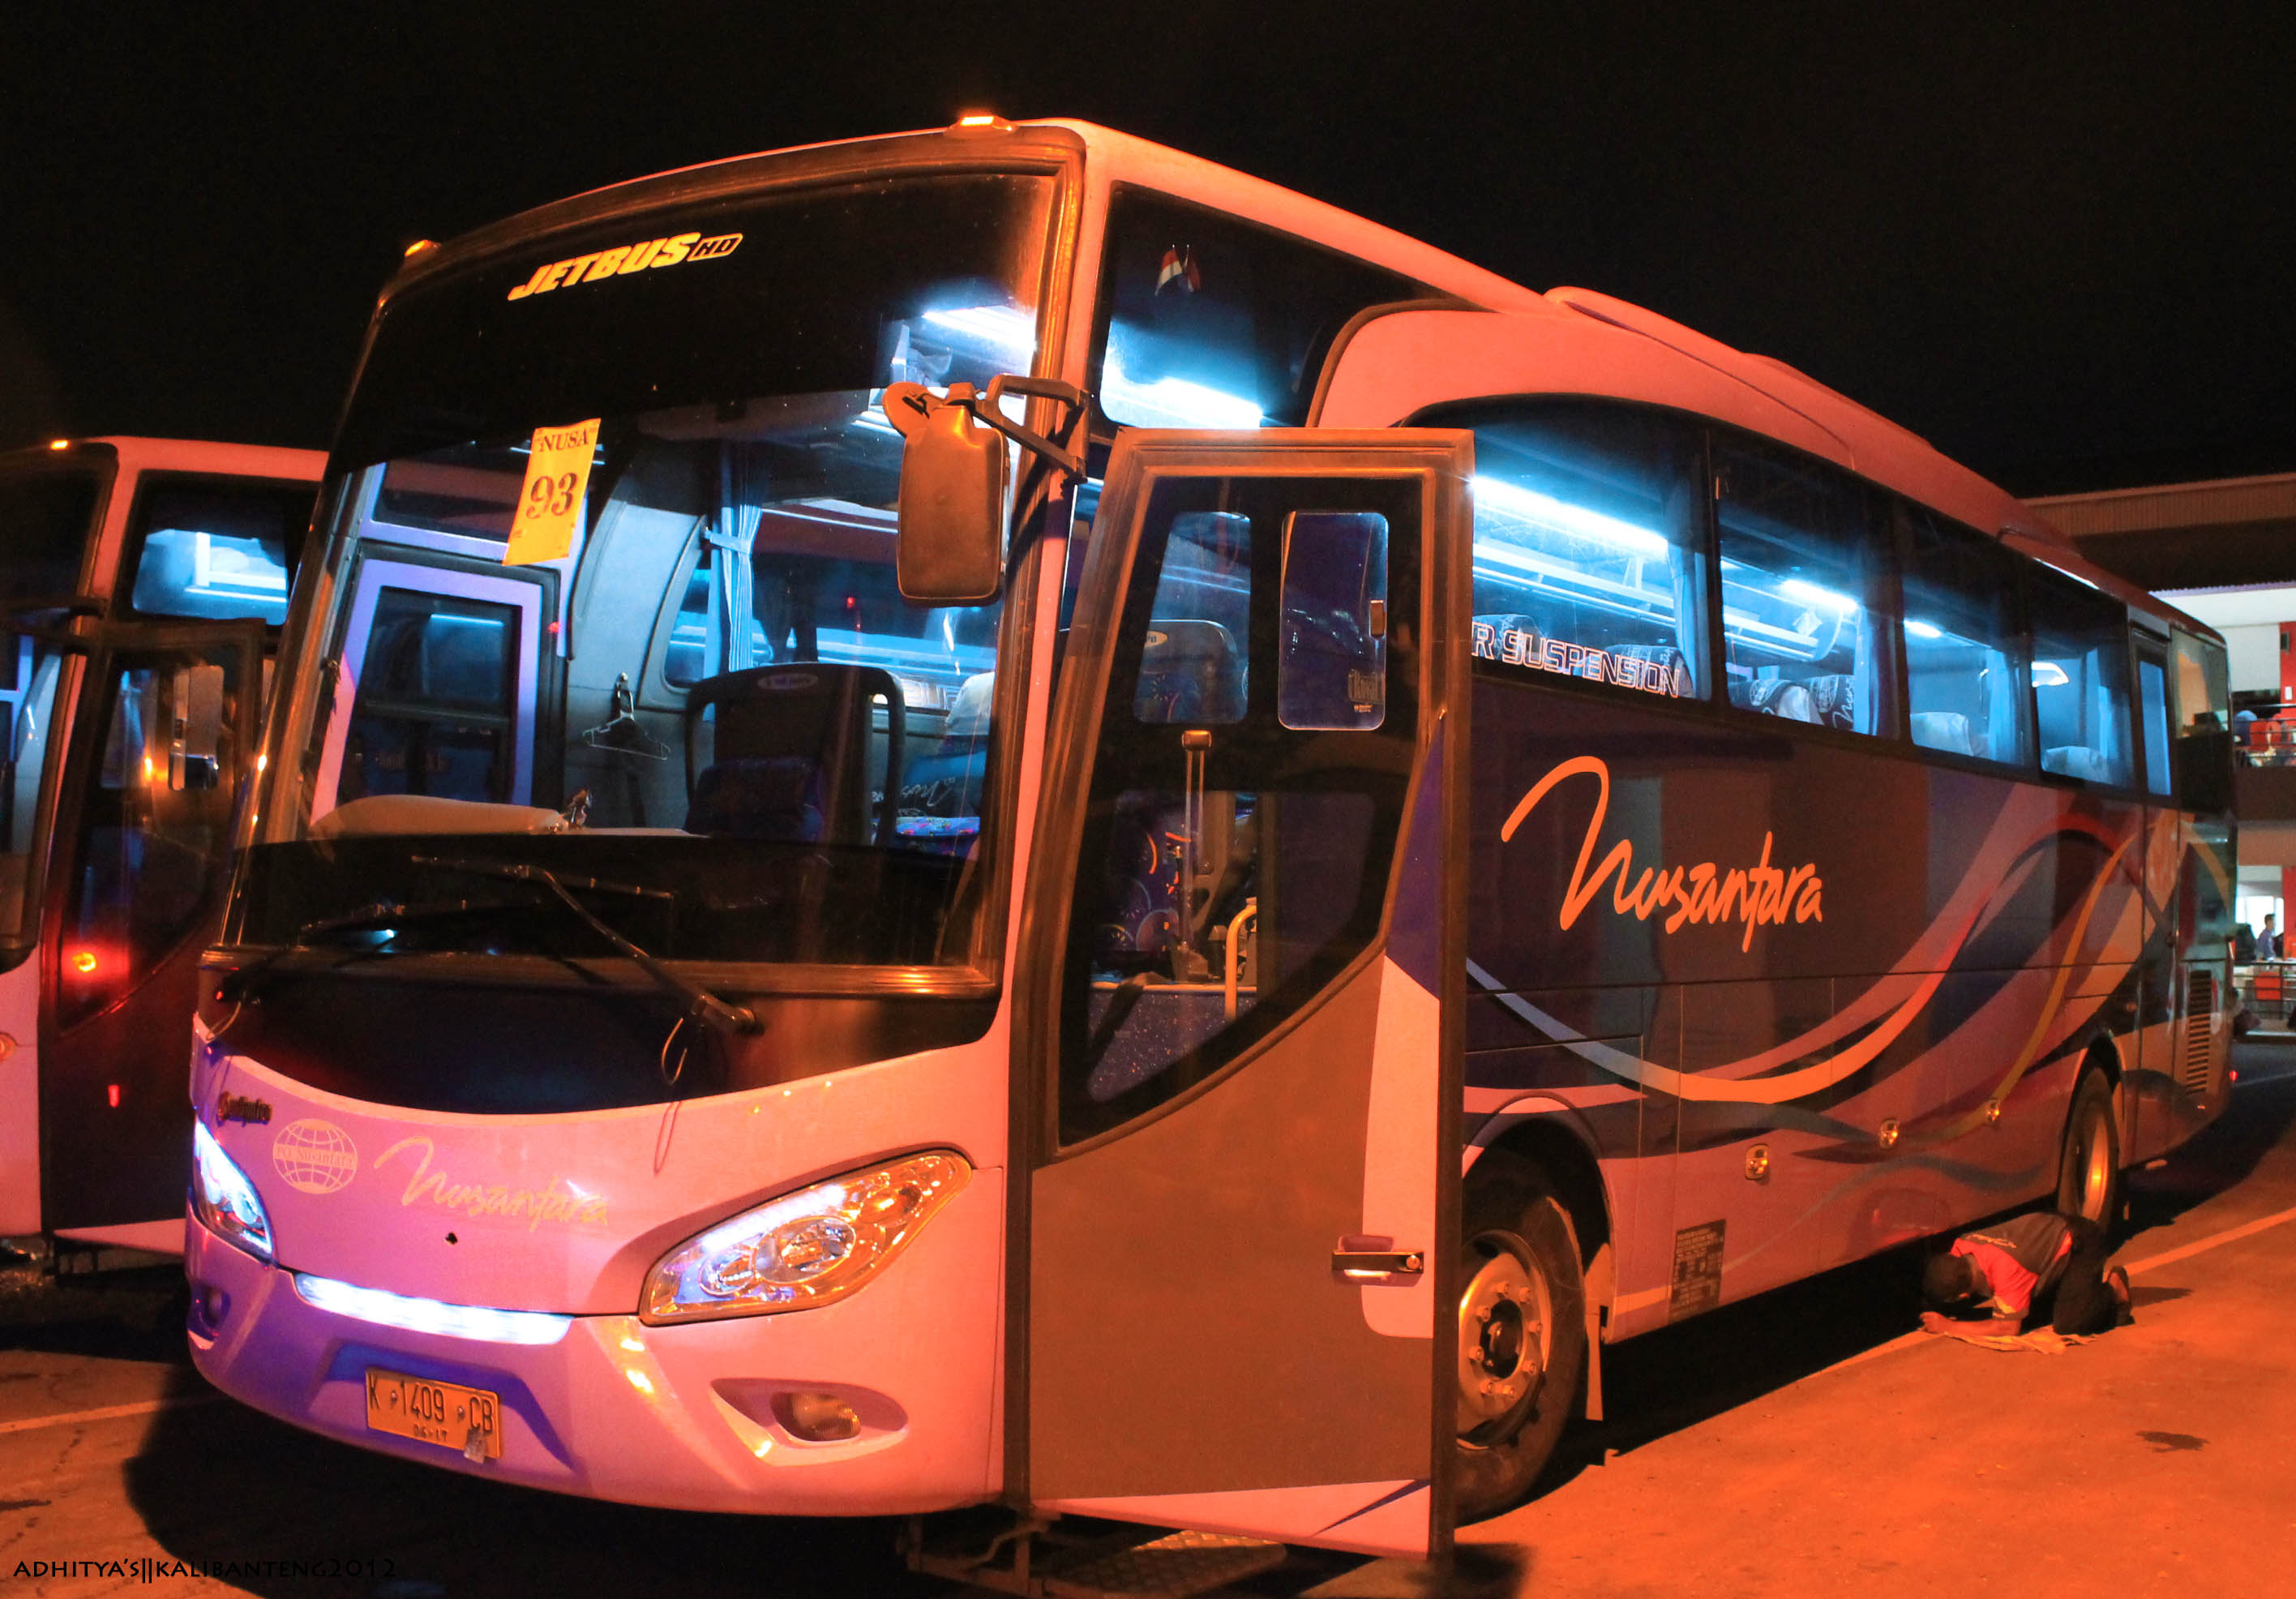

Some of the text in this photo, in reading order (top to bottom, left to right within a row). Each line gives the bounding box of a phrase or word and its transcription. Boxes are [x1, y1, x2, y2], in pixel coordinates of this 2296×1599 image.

[508, 232, 743, 301] JETBUS HD
[538, 427, 589, 452] NUSA
[525, 473, 577, 519] 93
[1502, 629, 1680, 698] SUSPENSION
[1501, 756, 1823, 953] Nusantara
[374, 1135, 608, 1233] Nusantara
[368, 1373, 493, 1434] K 1409 CB
